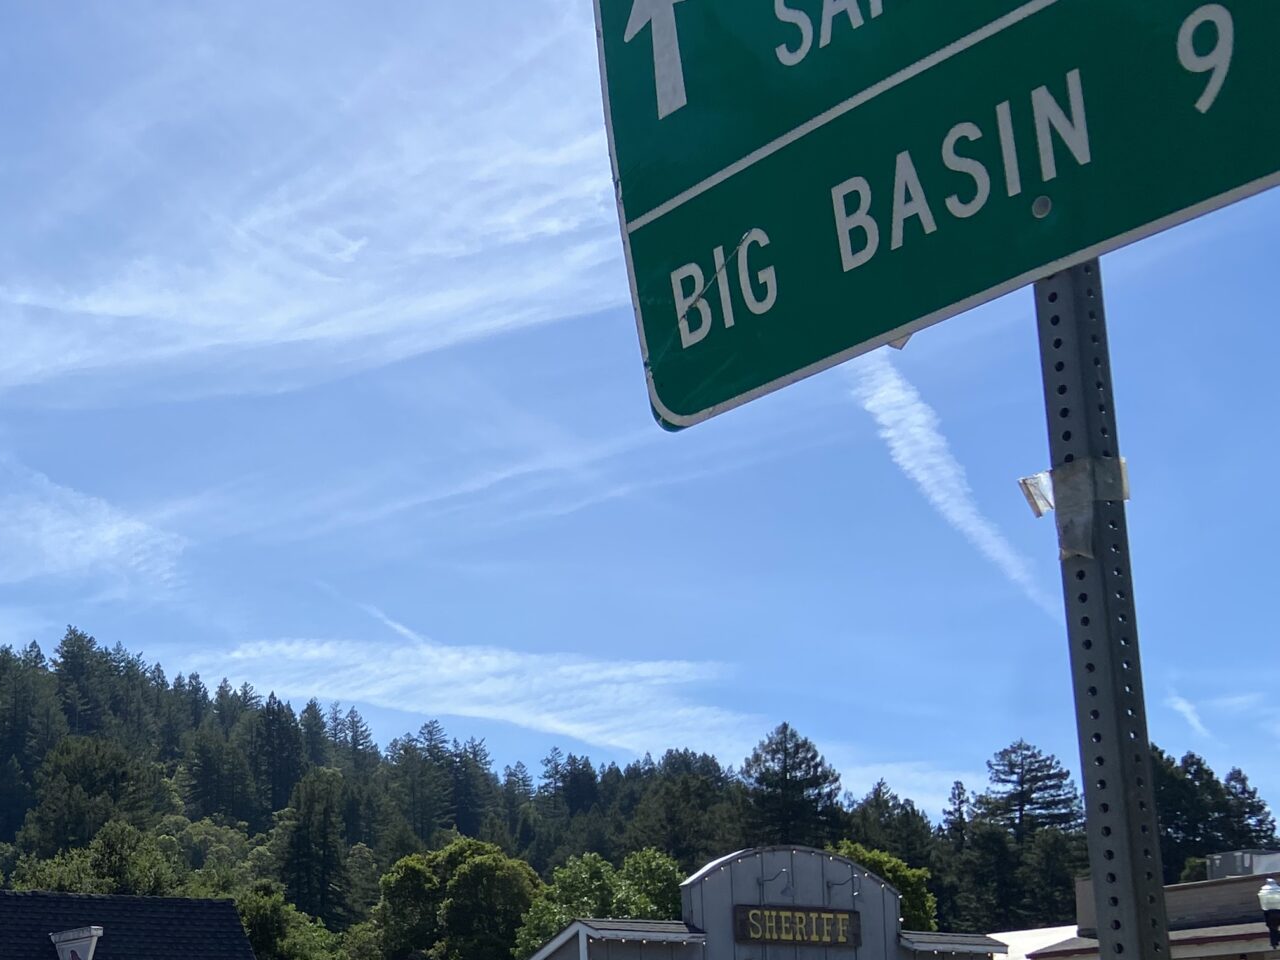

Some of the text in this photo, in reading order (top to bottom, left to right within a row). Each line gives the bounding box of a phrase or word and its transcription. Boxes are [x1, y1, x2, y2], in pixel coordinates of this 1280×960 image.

[774, 0, 883, 66] SA
[670, 4, 1235, 348] BIG BASIN 9
[748, 909, 849, 942] SHERIFF
